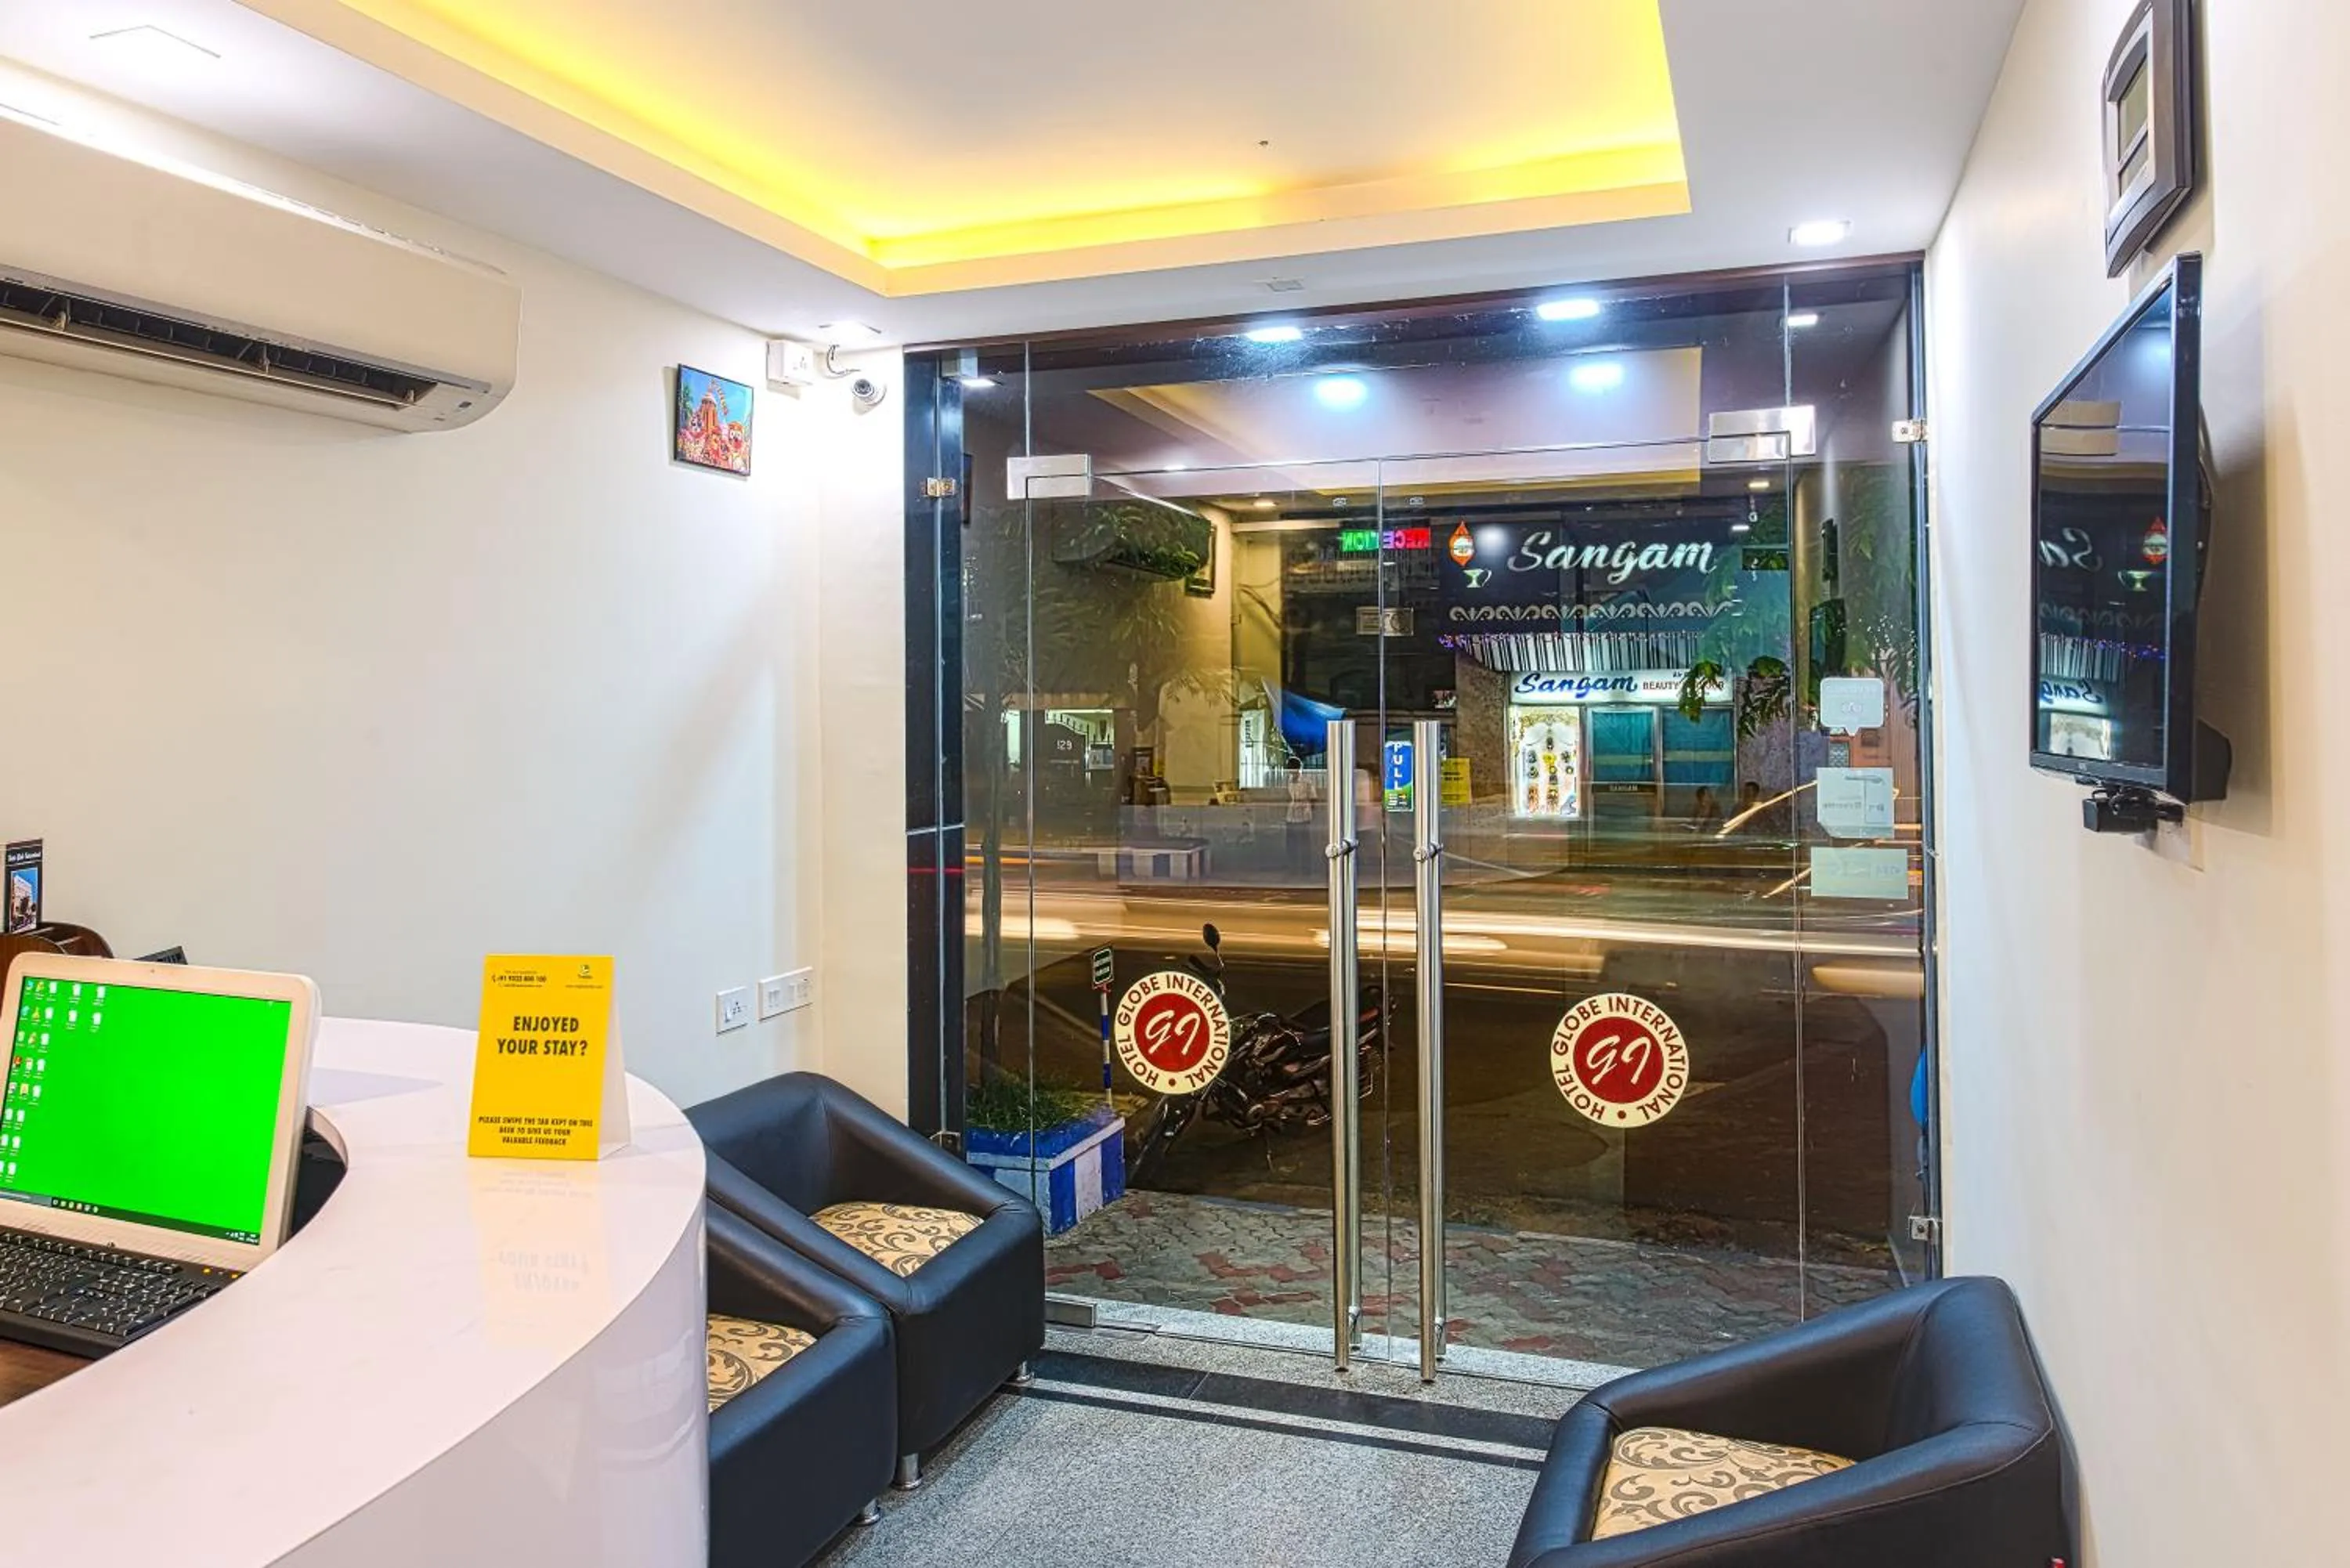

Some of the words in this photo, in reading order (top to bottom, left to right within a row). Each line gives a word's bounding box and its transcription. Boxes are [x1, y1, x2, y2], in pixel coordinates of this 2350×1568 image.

[1507, 531, 1718, 585] Sangam
[1515, 672, 1637, 699] Sangam
[1643, 681, 1679, 690] BEAUTY
[1393, 741, 1403, 790] PULL
[513, 1016, 579, 1032] ENJOYED
[1117, 977, 1161, 1026] GLOBE
[1553, 999, 1602, 1056] GLOBE
[497, 1039, 538, 1054] YOUR
[544, 1039, 588, 1056] STAY?
[1166, 974, 1228, 1088] INTERNATIONAL
[1607, 995, 1686, 1121] INTERNATIONAL
[1117, 1033, 1159, 1087] HOTEL
[1555, 1064, 1606, 1120] HOTEL
